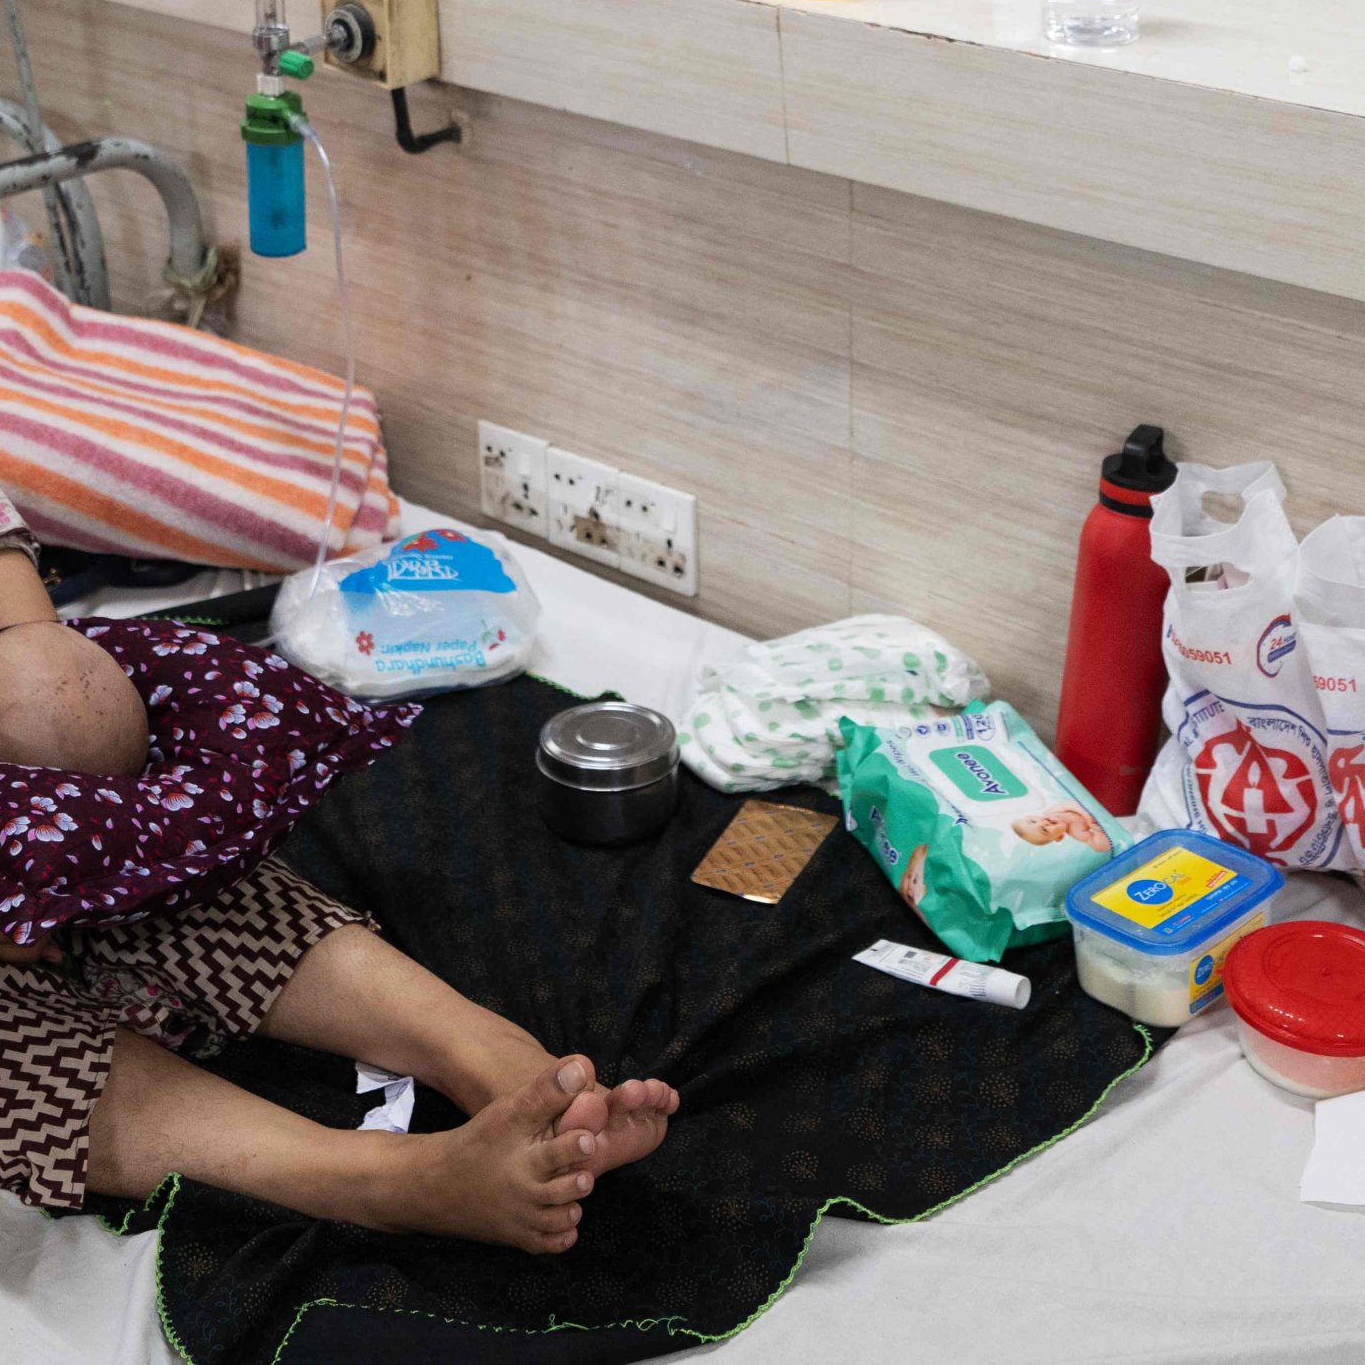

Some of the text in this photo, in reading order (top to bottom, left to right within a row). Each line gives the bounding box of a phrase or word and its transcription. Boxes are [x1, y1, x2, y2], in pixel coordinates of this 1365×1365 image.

[436, 641, 477, 654] Paper
[1270, 638, 1283, 650] 24
[375, 651, 486, 674] Bashundhara
[1248, 716, 1297, 732] বাংলাদেশ
[956, 751, 1008, 795] Avonee
